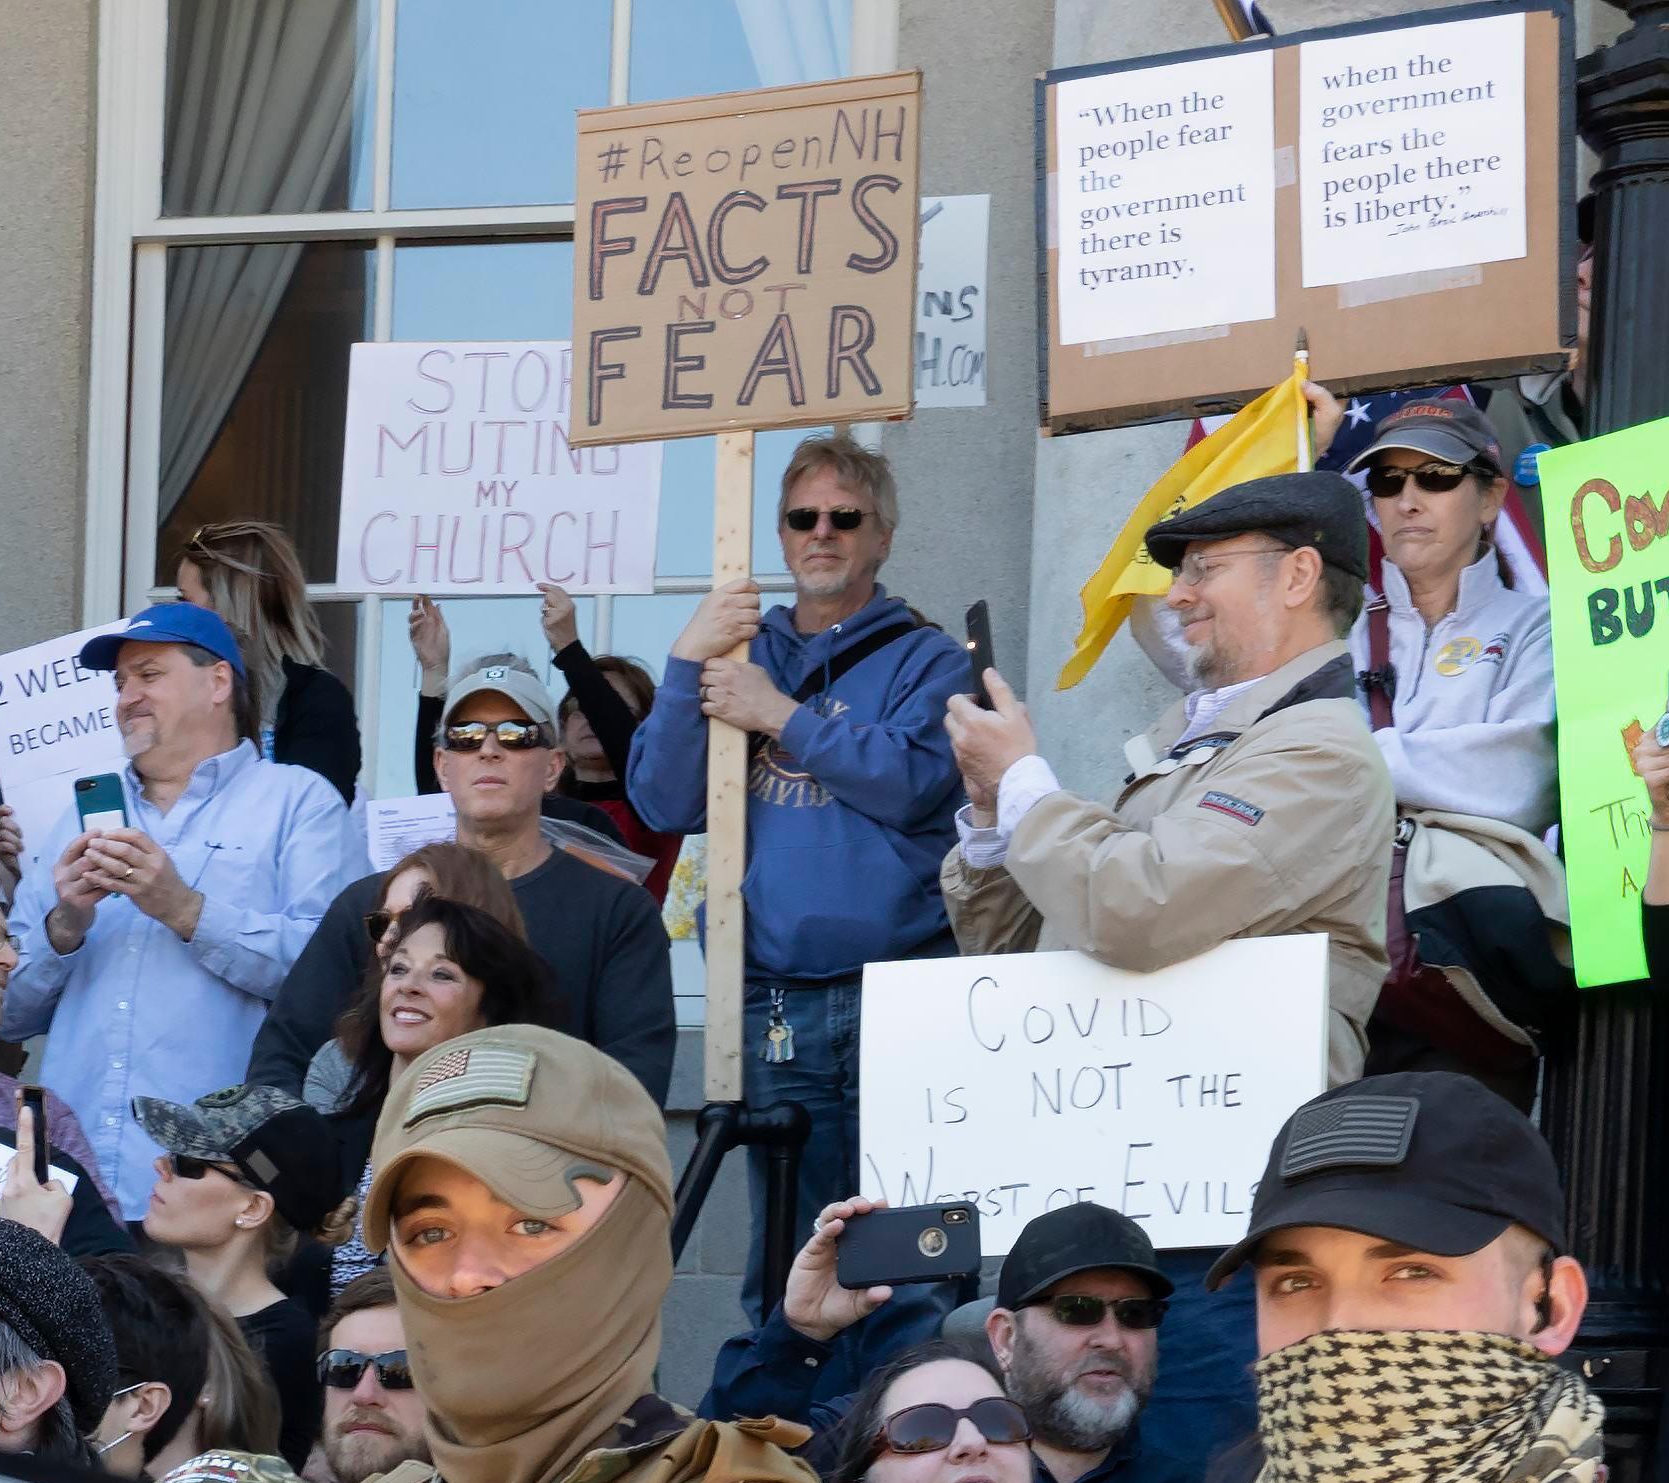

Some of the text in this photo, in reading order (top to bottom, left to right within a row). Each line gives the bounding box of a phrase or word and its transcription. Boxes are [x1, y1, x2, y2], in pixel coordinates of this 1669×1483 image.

[1322, 54, 1453, 90] when the
[1180, 91, 1224, 114] the
[1321, 80, 1496, 128] government
[598, 106, 905, 183] #ReopenNH
[1079, 124, 1232, 168] people fear
[1321, 127, 1447, 165] fears the
[1079, 170, 1123, 193] the
[1323, 154, 1502, 203] people there
[1080, 183, 1247, 230] government
[1323, 206, 1347, 229] is
[588, 174, 902, 301] FACTS
[1080, 222, 1183, 255] there is
[677, 284, 806, 321] NOT
[588, 305, 882, 427] FEAR
[475, 480, 519, 507] MY
[360, 510, 620, 586] CHURCH
[15, 655, 112, 697] WEE
[9, 707, 113, 755] BECAME
[1591, 797, 1652, 849] Thi
[968, 977, 1171, 1052] COVID
[926, 1062, 1242, 1124] IS NOT THE
